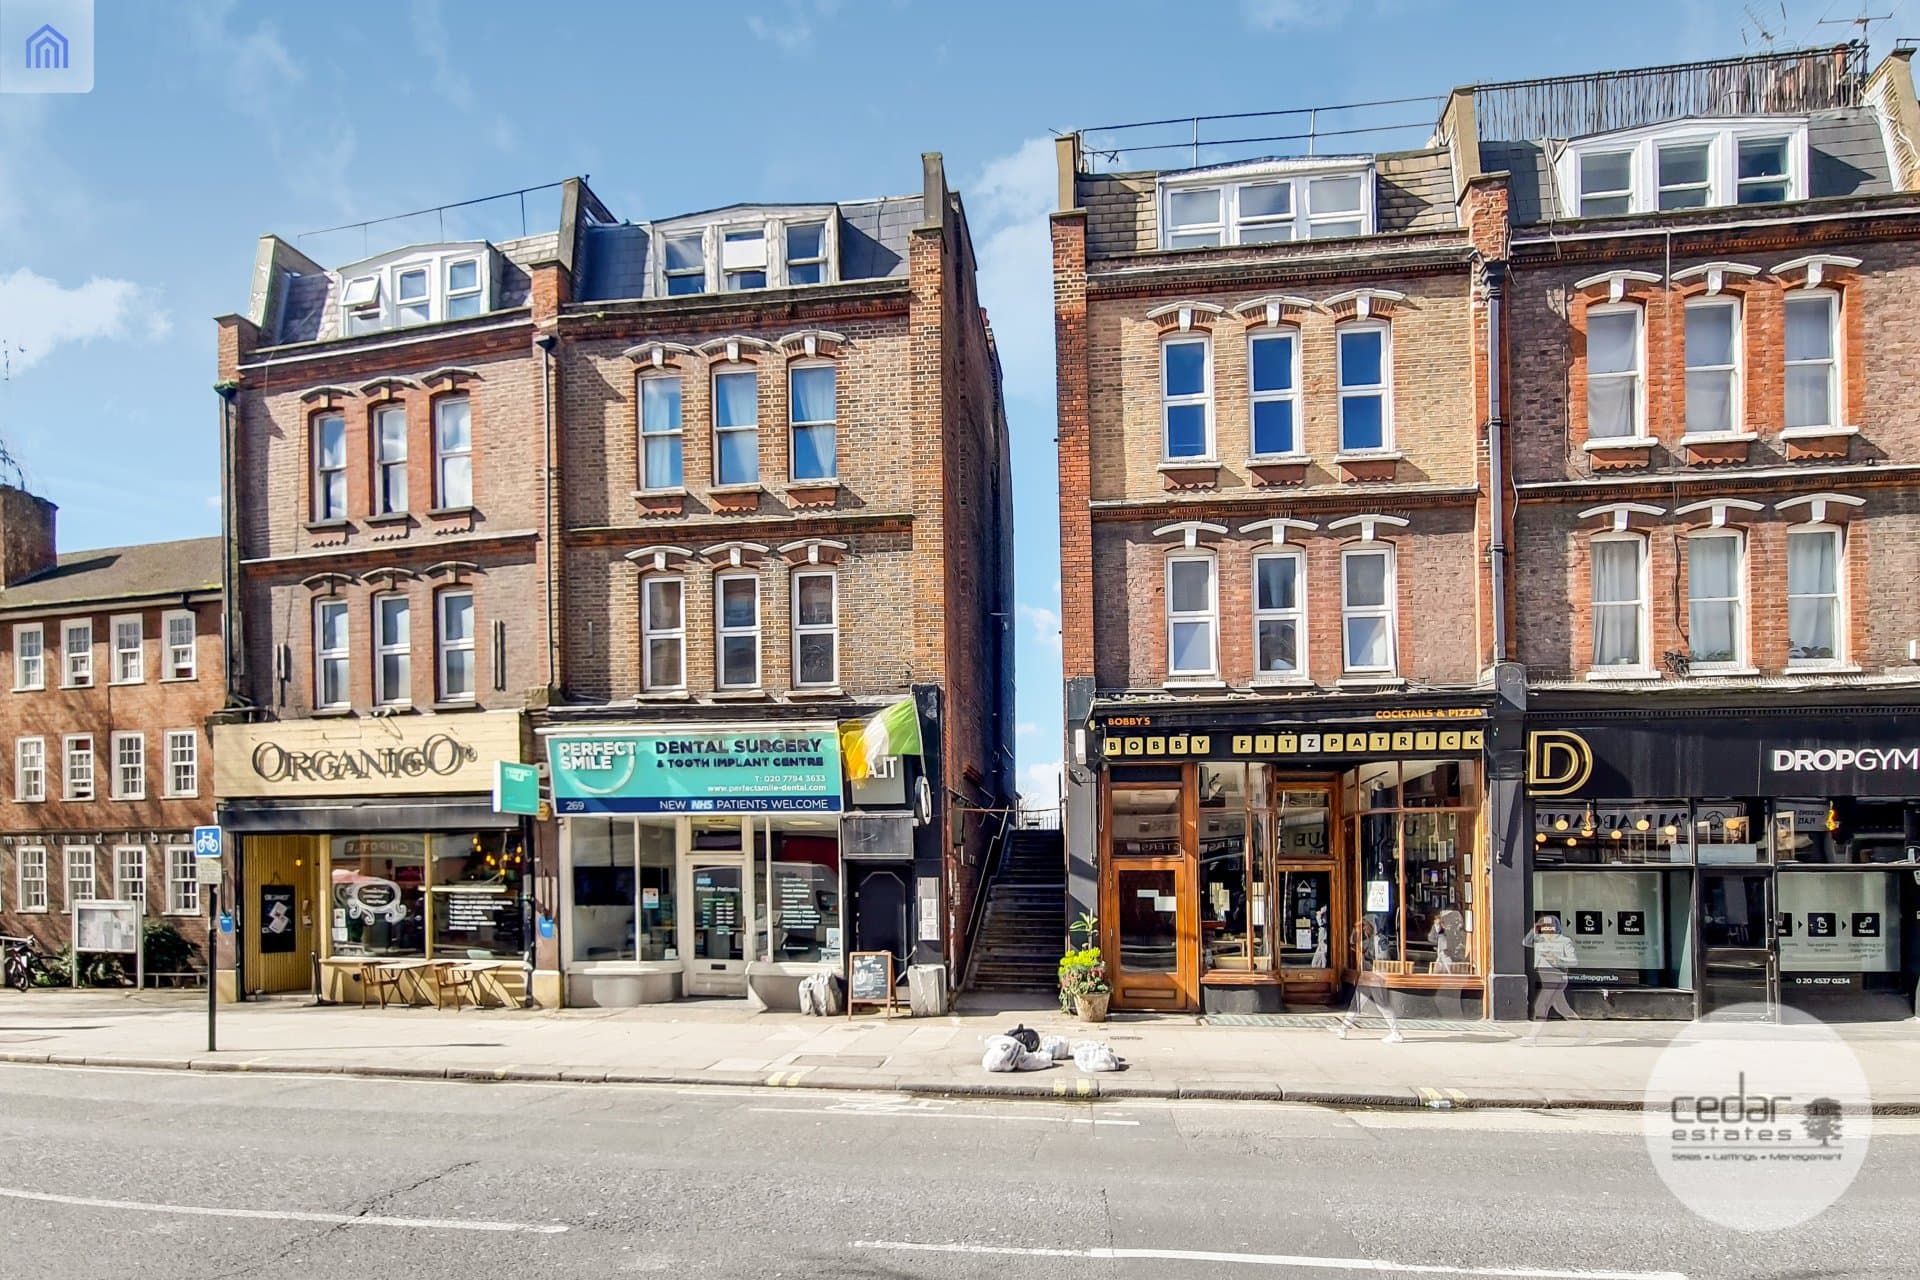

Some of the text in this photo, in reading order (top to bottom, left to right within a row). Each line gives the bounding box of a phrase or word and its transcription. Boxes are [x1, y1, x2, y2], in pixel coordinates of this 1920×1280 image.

[1375, 708, 1483, 719] COCKTAILS & PIZZA
[1107, 717, 1151, 726] BOBBY'S
[558, 742, 637, 756] PERFECT
[655, 738, 822, 754] DENTAL SURGERY
[1108, 734, 1480, 752] BOBBY FITZPATRICK
[252, 734, 463, 782] ORGANICO
[560, 755, 613, 770] SMILE
[656, 757, 824, 769] & TOOTH IMPLANT CENTRE
[1773, 748, 1919, 771] DROPGYM
[707, 783, 827, 793] www.perfectsmile-dental.com
[565, 801, 585, 811] 269
[659, 799, 829, 809] NEW NHS PATIENTS WELCOME
